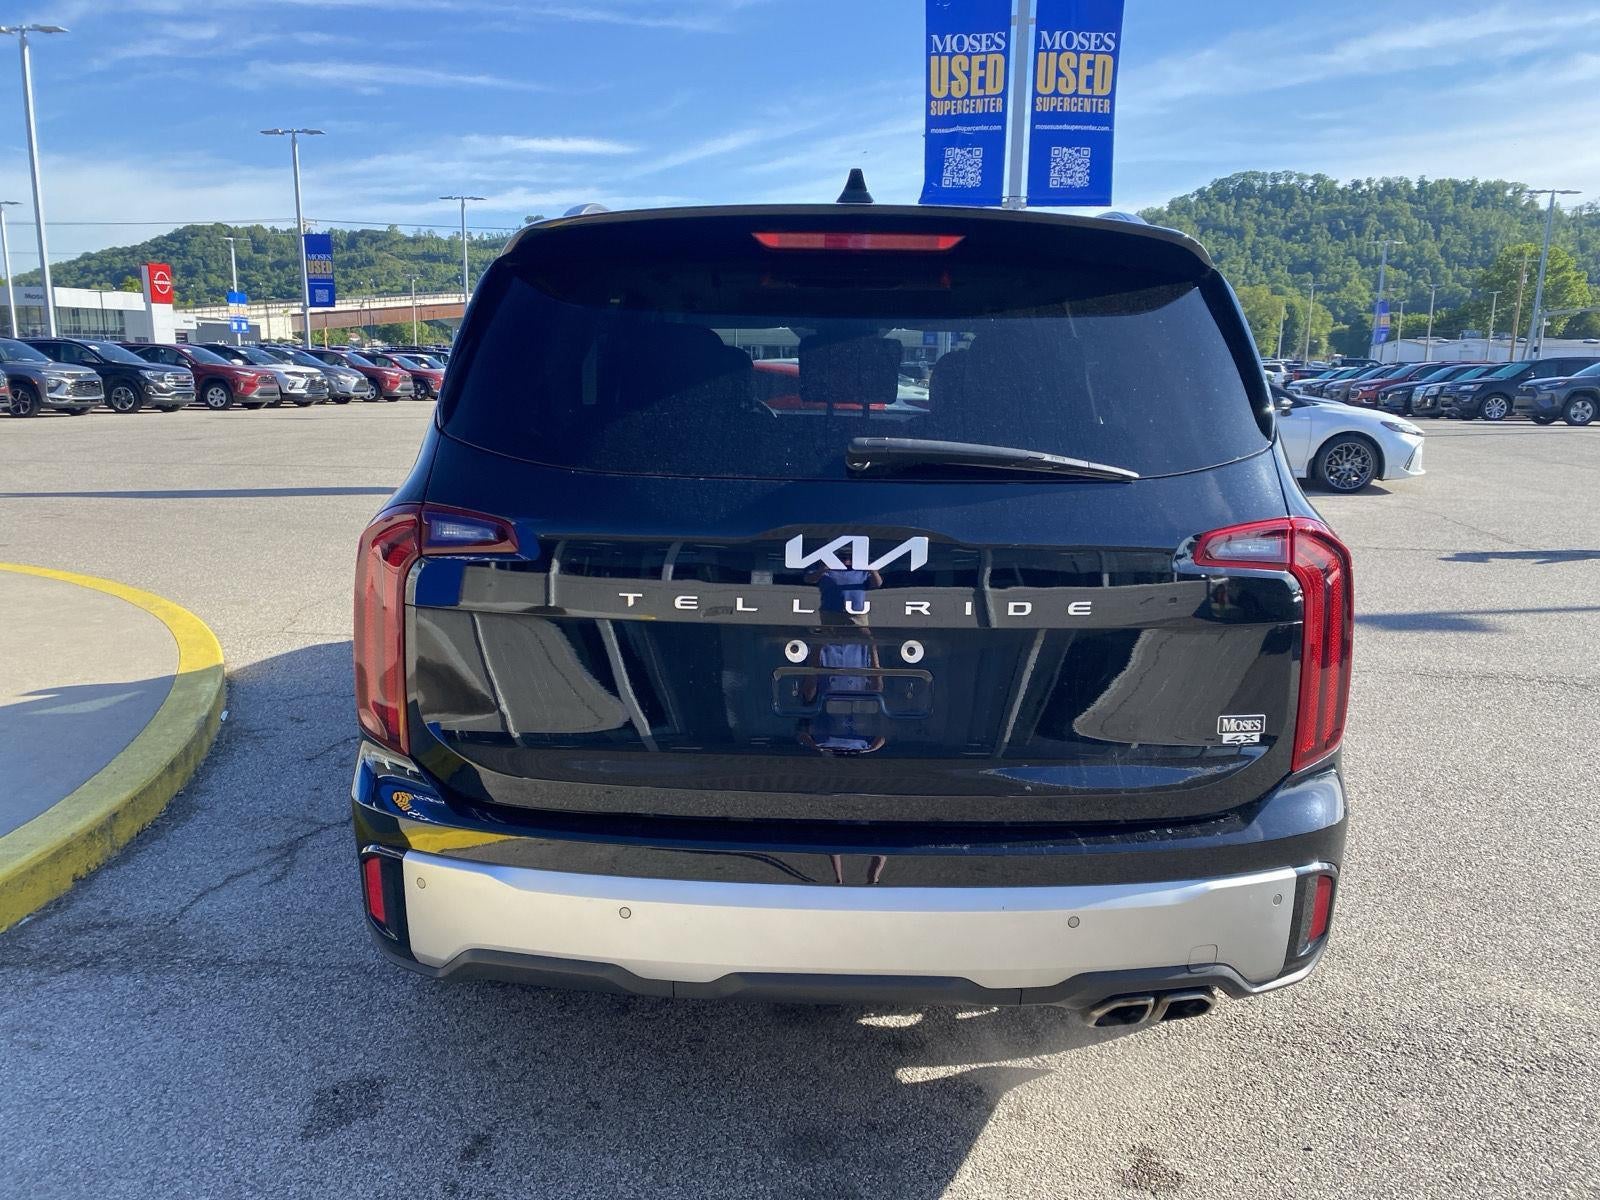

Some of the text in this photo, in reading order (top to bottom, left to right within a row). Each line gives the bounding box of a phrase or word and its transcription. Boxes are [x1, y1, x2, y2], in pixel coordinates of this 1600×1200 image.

[931, 31, 1006, 53] MOSES
[1040, 30, 1116, 52] MOSES
[930, 54, 1005, 99] USED
[1036, 52, 1114, 96] USED
[930, 98, 1003, 116] SUPERCENTER
[1035, 97, 1110, 114] SUPERCENTER
[307, 253, 332, 261] MOSES
[307, 260, 333, 274] USED
[784, 533, 929, 572] KIA
[618, 591, 1093, 617] TELLURIDE
